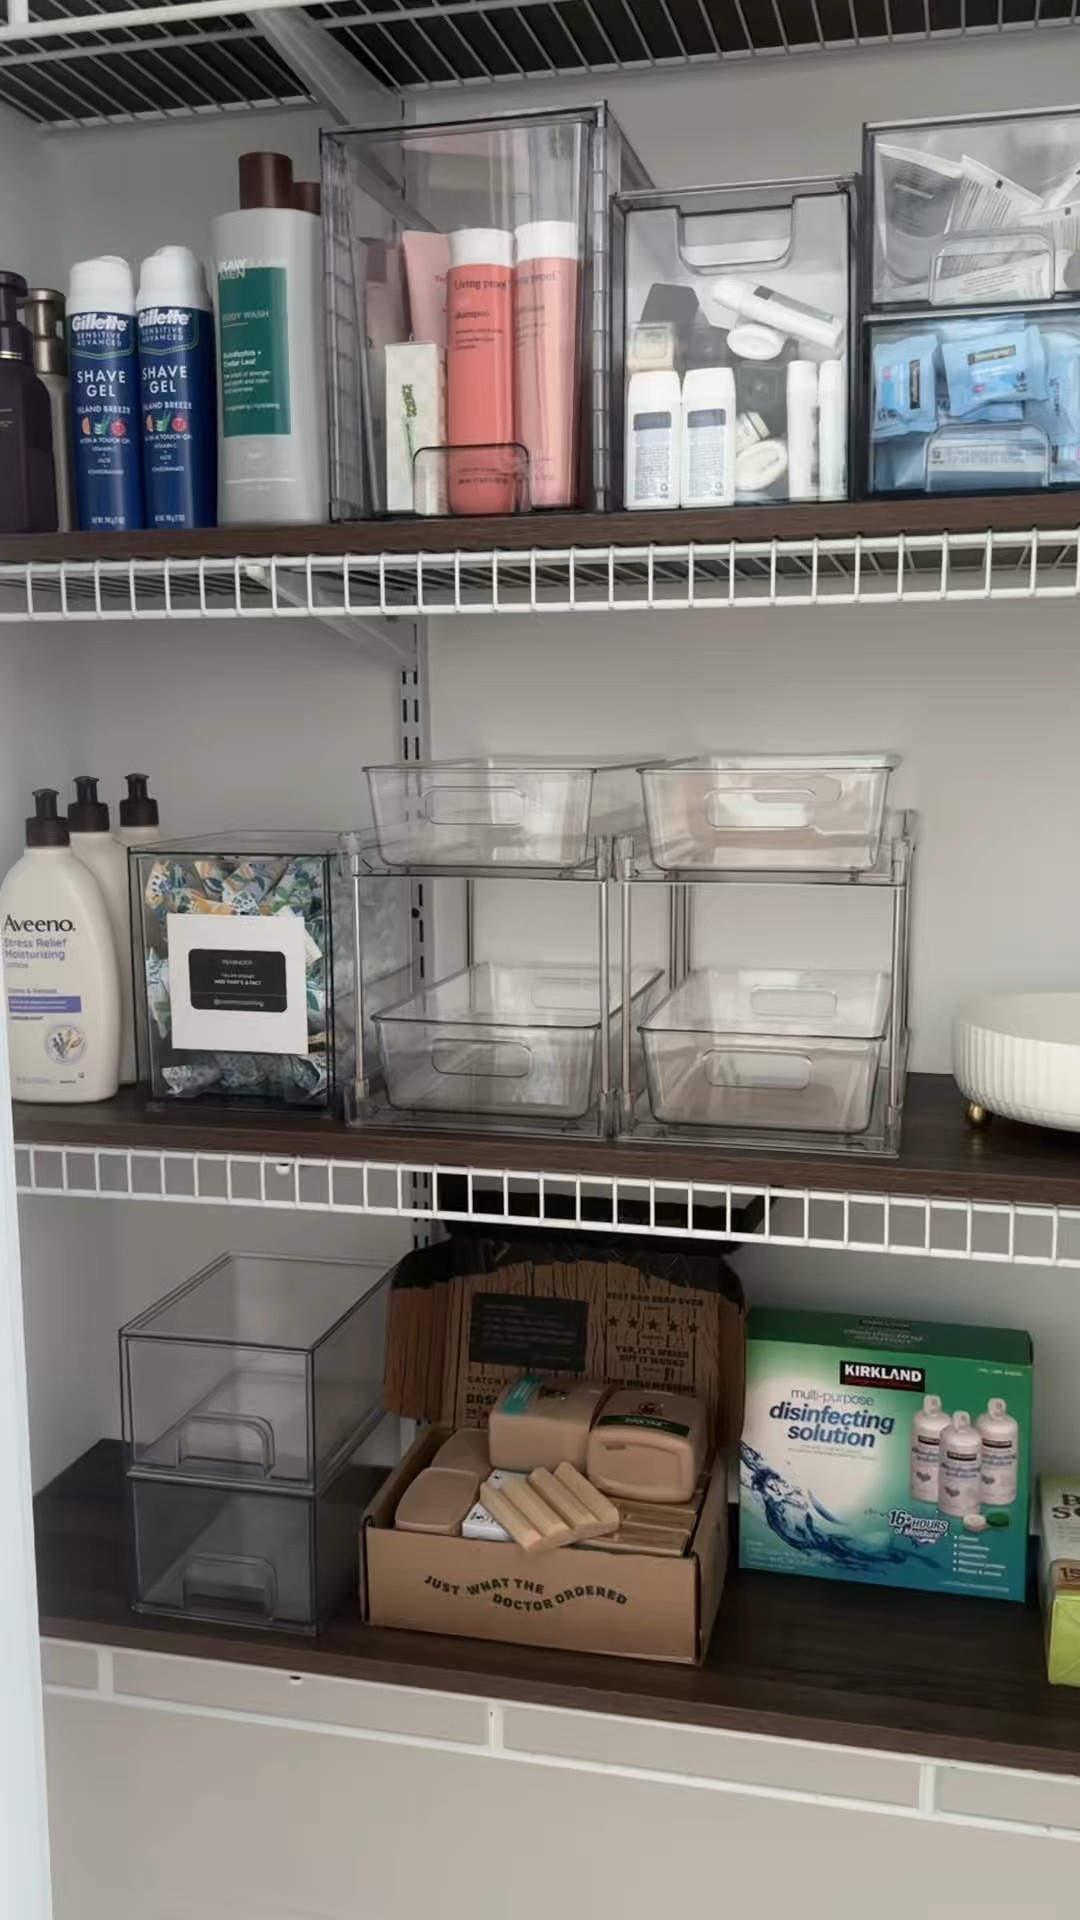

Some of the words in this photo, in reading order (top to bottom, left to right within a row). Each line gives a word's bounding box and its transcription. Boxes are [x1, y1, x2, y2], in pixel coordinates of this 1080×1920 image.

[454, 280, 481, 290] Living
[138, 308, 189, 328] Gillette
[243, 310, 270, 319] WASH
[72, 313, 127, 331] Gillette
[76, 339, 122, 347] ADVANCED
[77, 370, 126, 384] SHAVE
[142, 366, 188, 380] SHAVE
[86, 384, 116, 397] GEL
[149, 380, 177, 393] GEL
[103, 405, 131, 414] BREEZE
[165, 401, 192, 410] BREEZE
[4, 938, 33, 948] Stress
[36, 938, 66, 948] Relief
[4, 950, 65, 961] Moisturizing
[844, 1363, 923, 1383] KIRKLAND
[468, 1376, 502, 1385] CATCH
[791, 1388, 874, 1406] multi-purpose
[769, 1401, 895, 1435] disinfecting
[787, 1423, 876, 1448] solution
[911, 1518, 948, 1531] HOURS
[424, 1575, 460, 1595] JUST
[466, 1577, 510, 1596] WHAT
[513, 1578, 545, 1595] THE
[492, 1593, 554, 1611] DOCTOR
[555, 1585, 628, 1605] ORDERED
